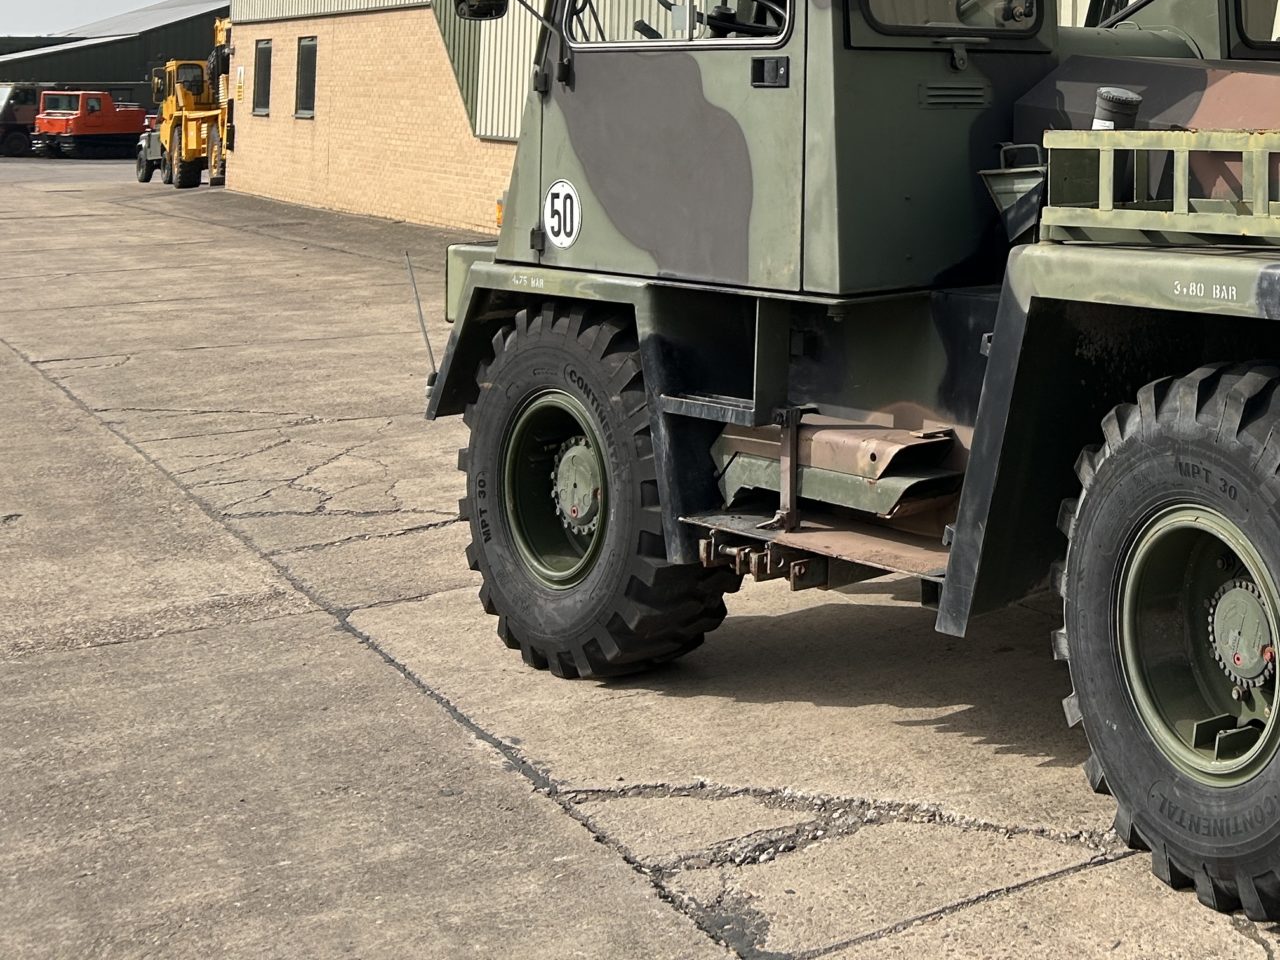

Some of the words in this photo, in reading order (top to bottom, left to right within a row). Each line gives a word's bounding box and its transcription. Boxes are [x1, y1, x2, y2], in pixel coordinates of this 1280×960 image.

[550, 192, 574, 238] 50
[1212, 284, 1237, 301] BAR
[477, 478, 487, 499] 30
[1177, 461, 1212, 484] MPT
[1219, 477, 1238, 501] 30
[479, 507, 493, 544] MPT
[1157, 792, 1278, 837] CONTINENTAL
